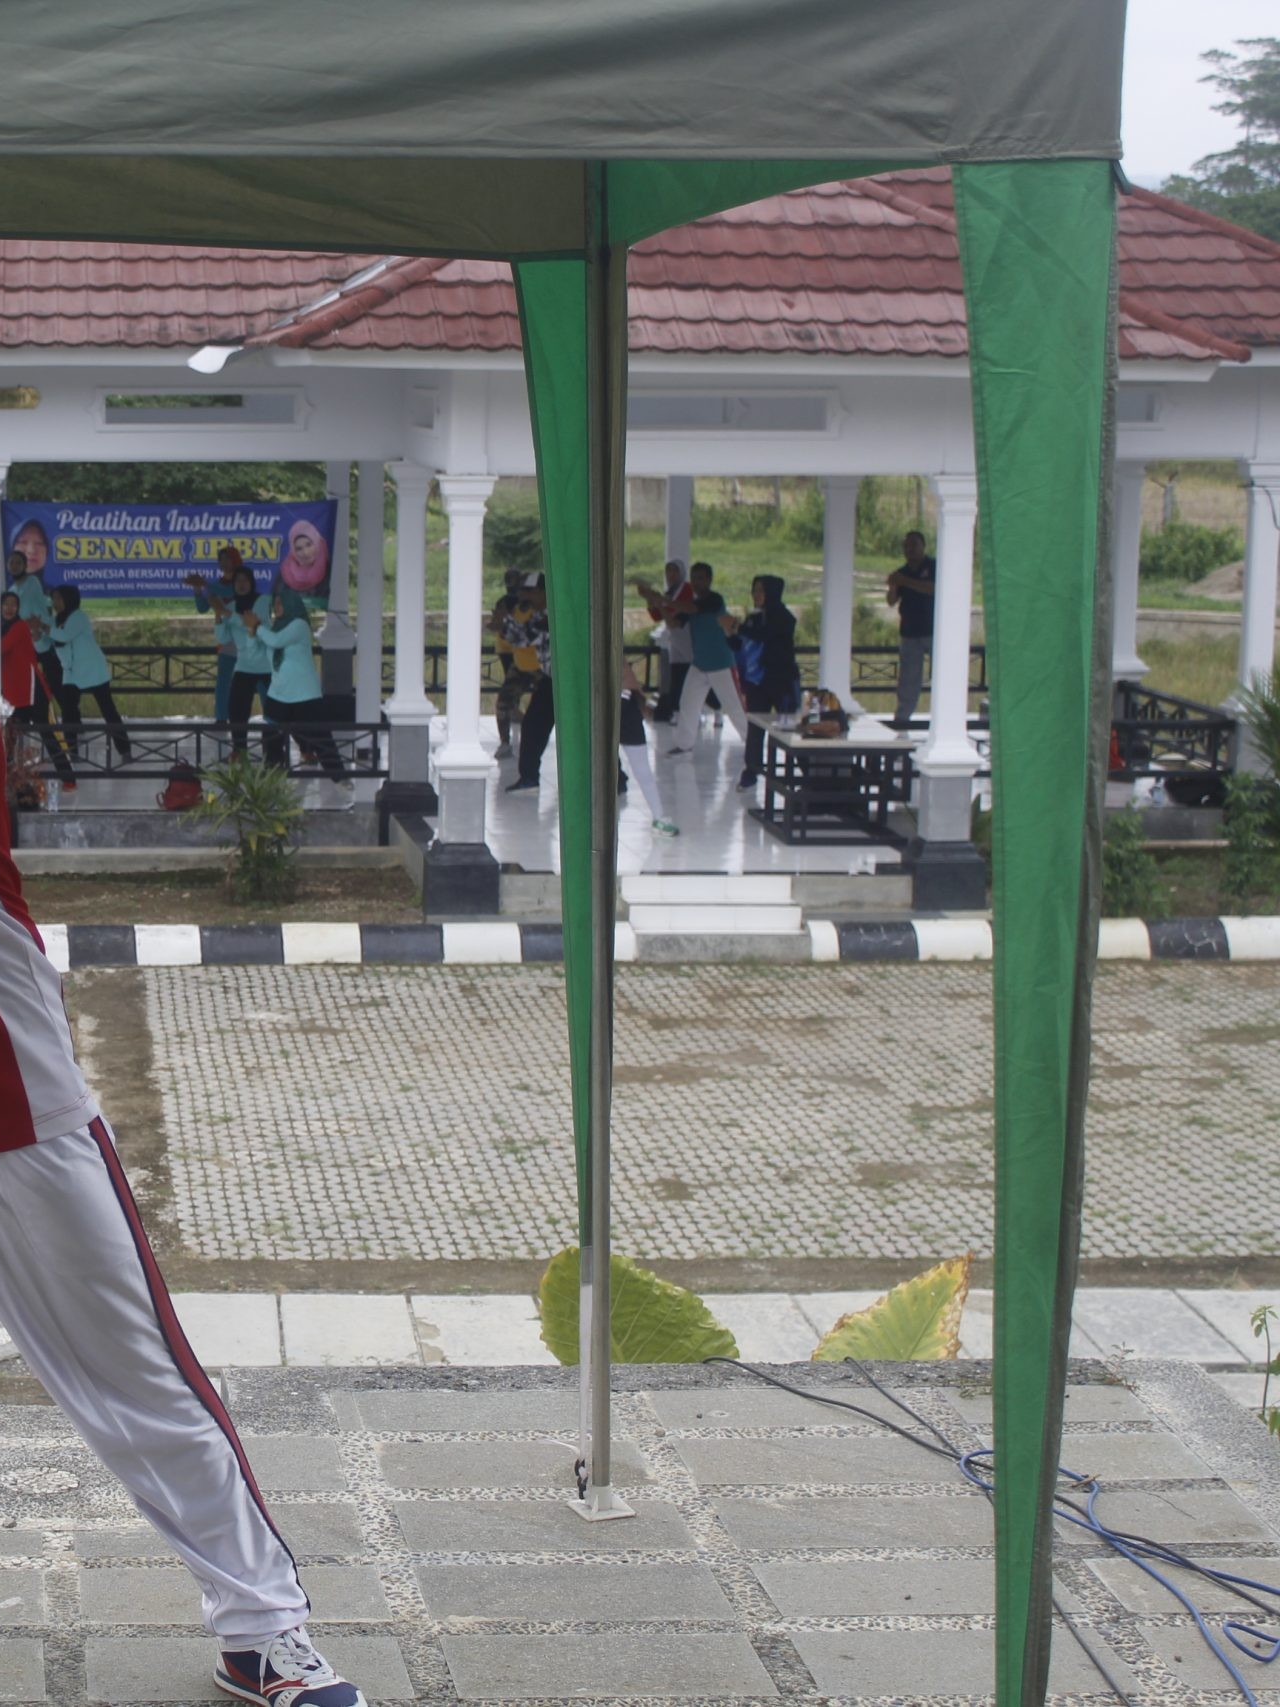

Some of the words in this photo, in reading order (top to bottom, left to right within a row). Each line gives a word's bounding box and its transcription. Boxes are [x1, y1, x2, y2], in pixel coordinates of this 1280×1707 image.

[56, 509, 161, 532] Pelatihan
[166, 509, 281, 532] Instruktur
[54, 535, 184, 562] SENAM
[63, 568, 125, 582] (INDONESIA
[127, 568, 174, 581] BERSATU
